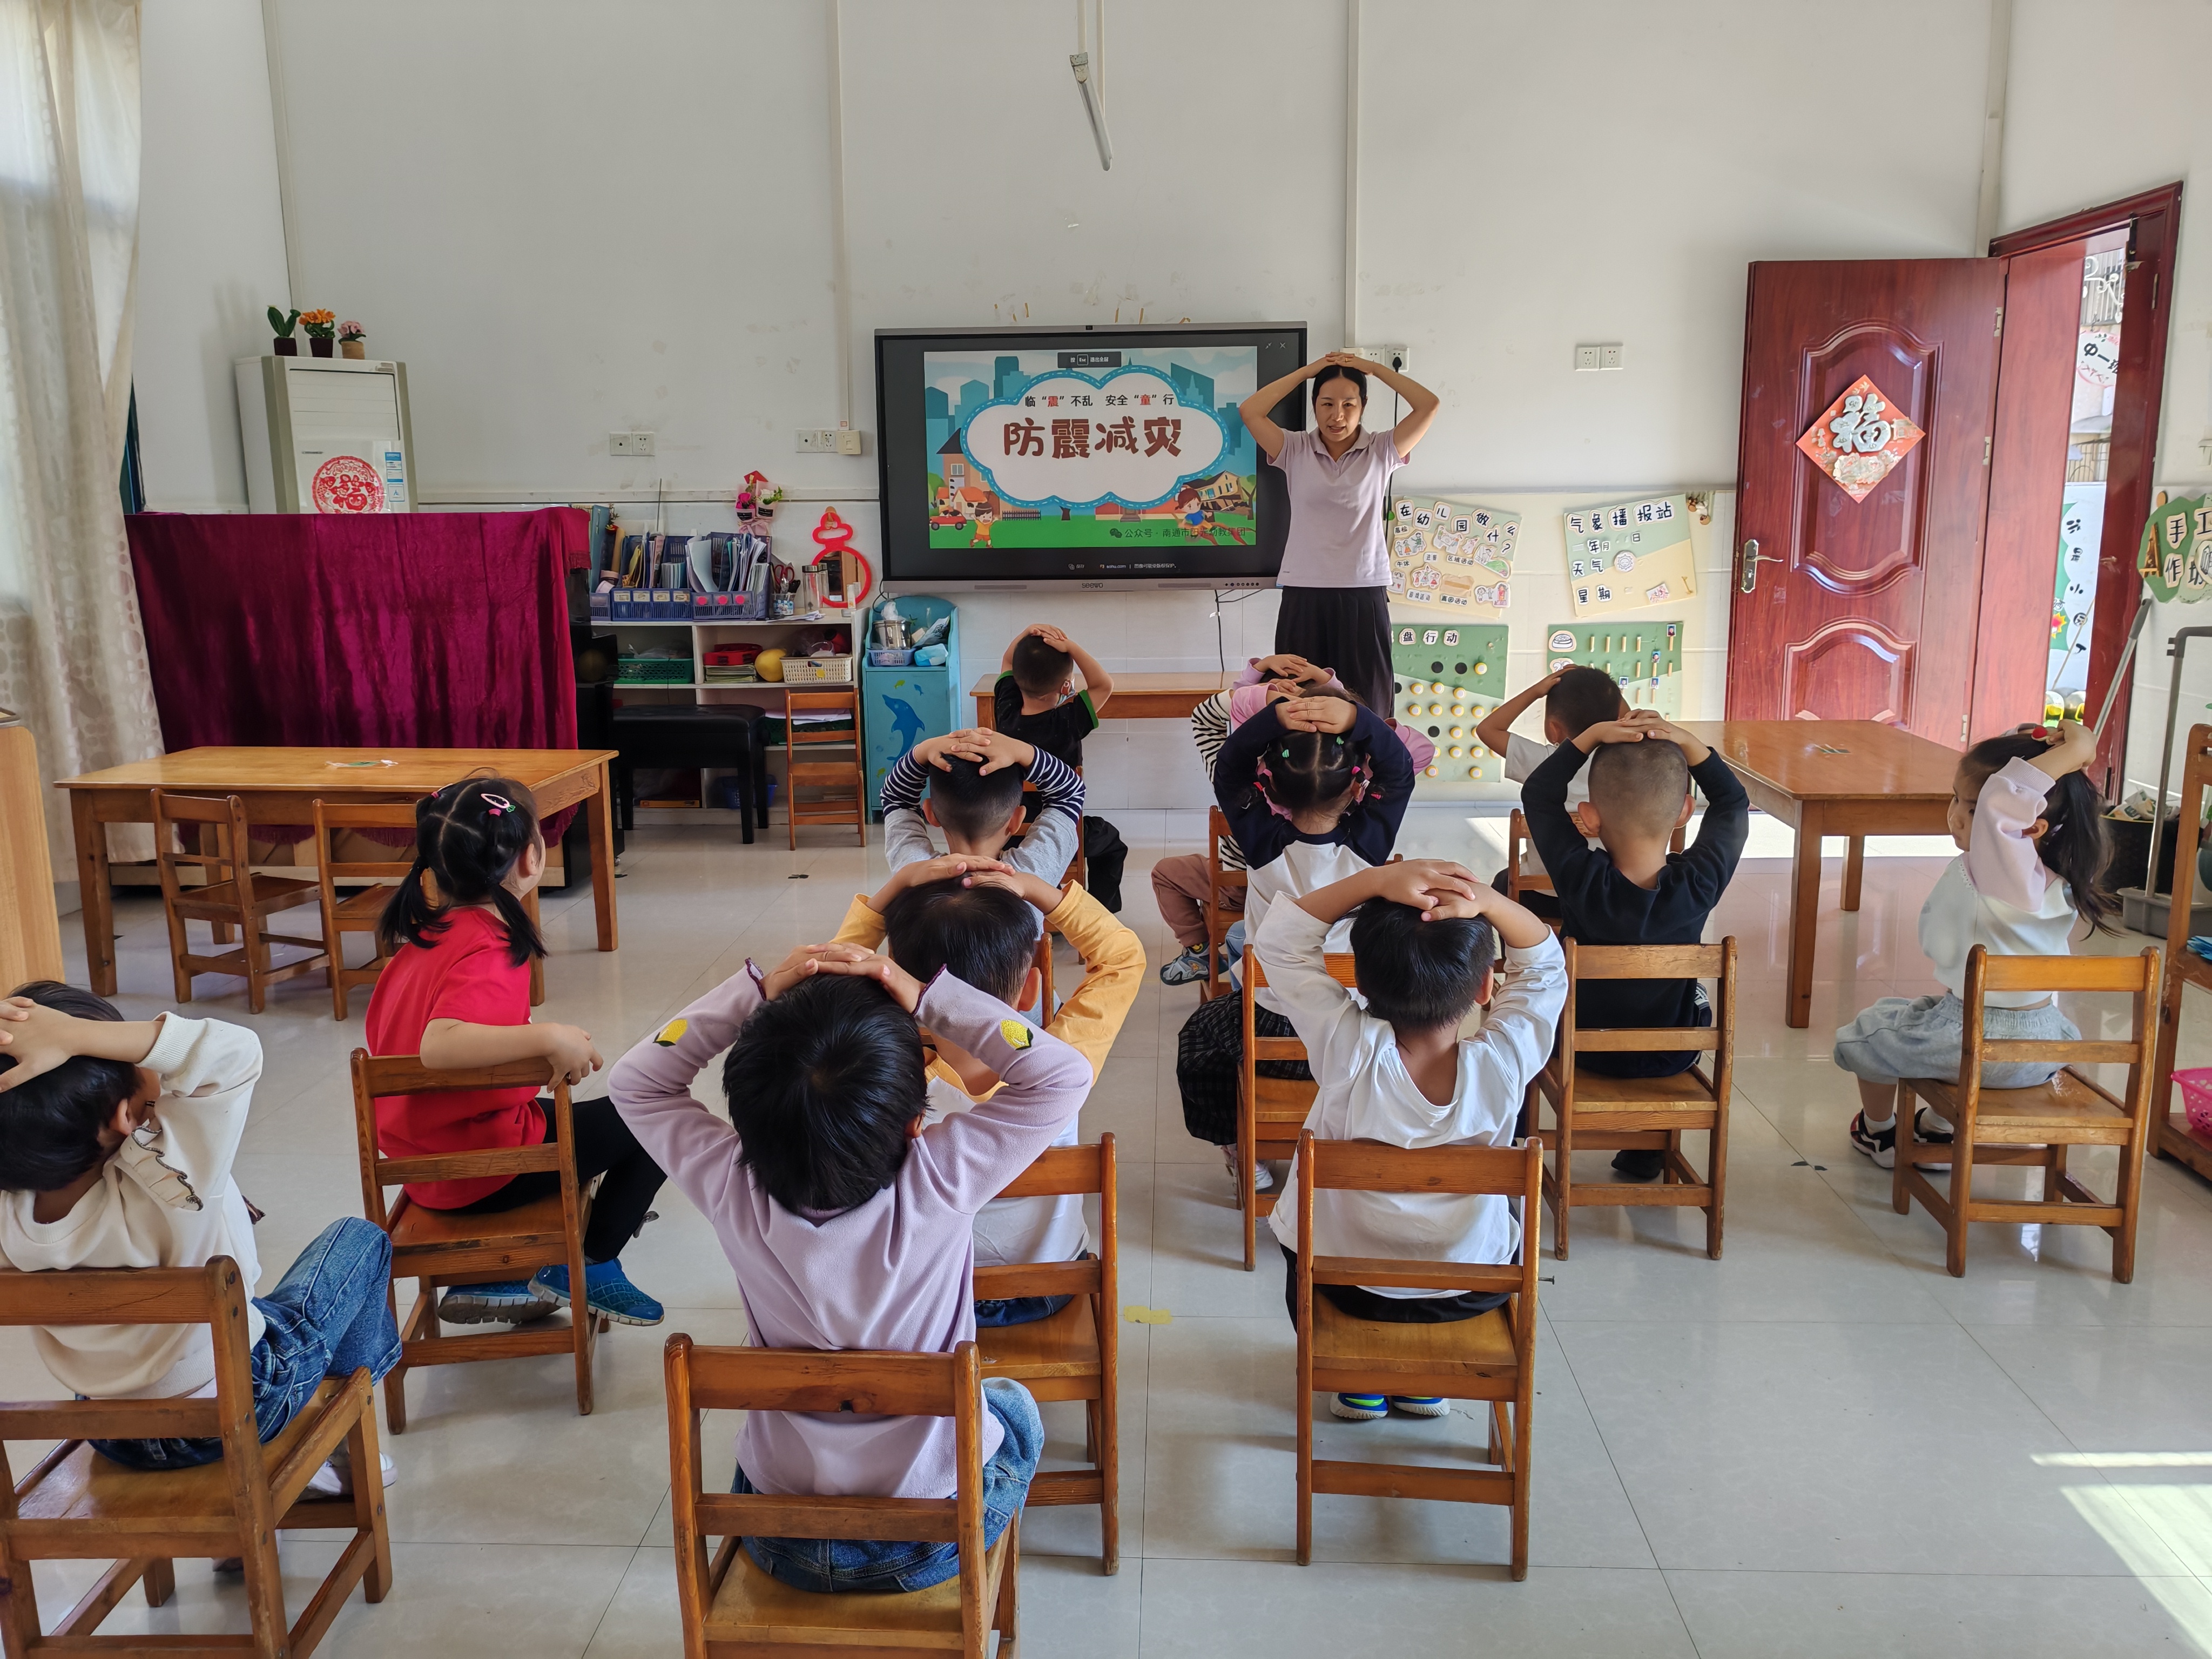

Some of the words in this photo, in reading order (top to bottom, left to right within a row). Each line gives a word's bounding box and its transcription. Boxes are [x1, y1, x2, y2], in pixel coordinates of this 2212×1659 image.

[1829, 393, 1891, 453] 福
[1003, 415, 1182, 459] 防震减灾
[1570, 502, 1673, 534] 气象播报站
[2169, 510, 2212, 543] 手工
[1124, 529, 1152, 538] 公众号
[1448, 555, 1474, 565] 区域活动
[1573, 559, 1603, 576] 天气
[1579, 587, 1611, 603] 星期
